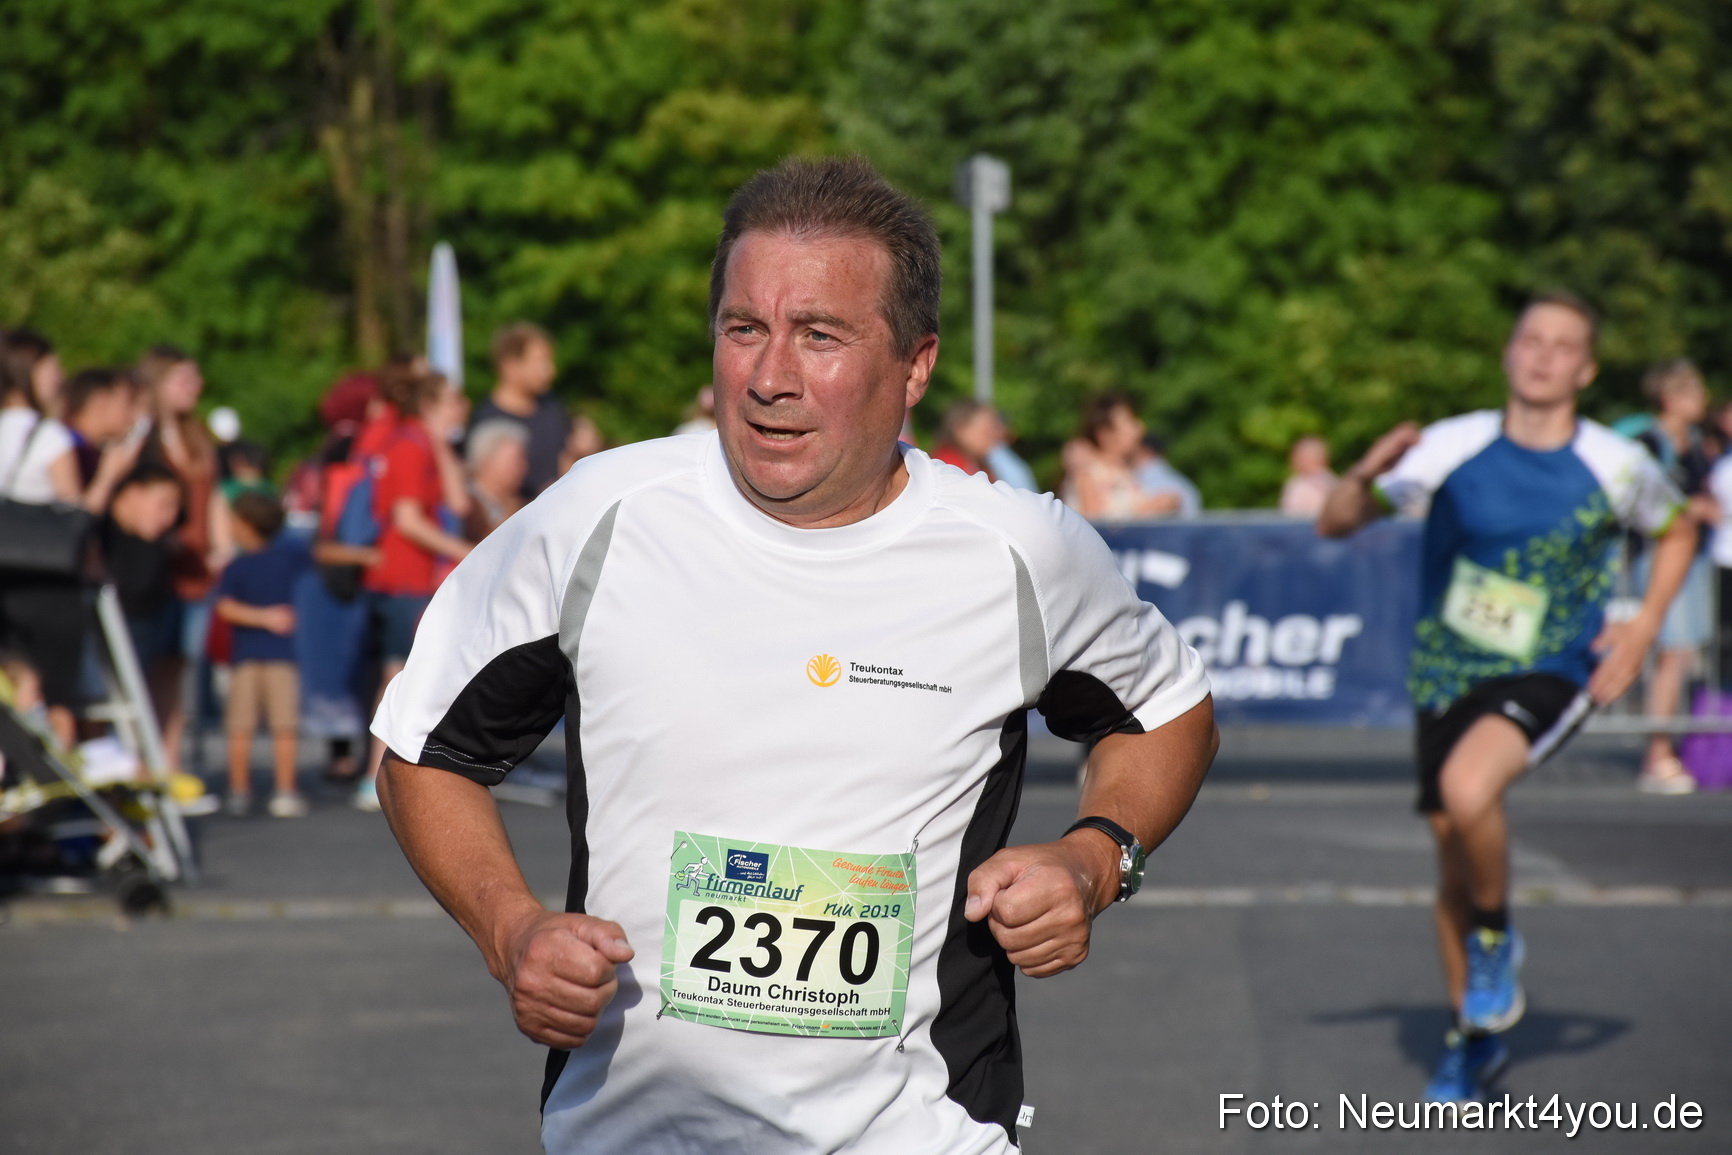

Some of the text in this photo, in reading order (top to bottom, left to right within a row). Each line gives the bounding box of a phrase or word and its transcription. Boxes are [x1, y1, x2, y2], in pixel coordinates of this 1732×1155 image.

[1176, 600, 1363, 667] cher
[850, 662, 903, 676] Treukontax
[849, 675, 952, 694] Steuerberatungsgesellschaft mbH
[733, 857, 762, 868] Fischer
[832, 857, 905, 879] Gesunde Firmen
[706, 873, 805, 901] firmenlauf
[849, 873, 912, 896] laufen länger!
[705, 891, 747, 903] neumarkt
[823, 902, 901, 918] run 2019
[690, 906, 879, 985] 2370
[671, 988, 891, 1017] Treukontax Steuerberatungsgesellschaft mbH
[708, 975, 860, 1008] Daum Christoph
